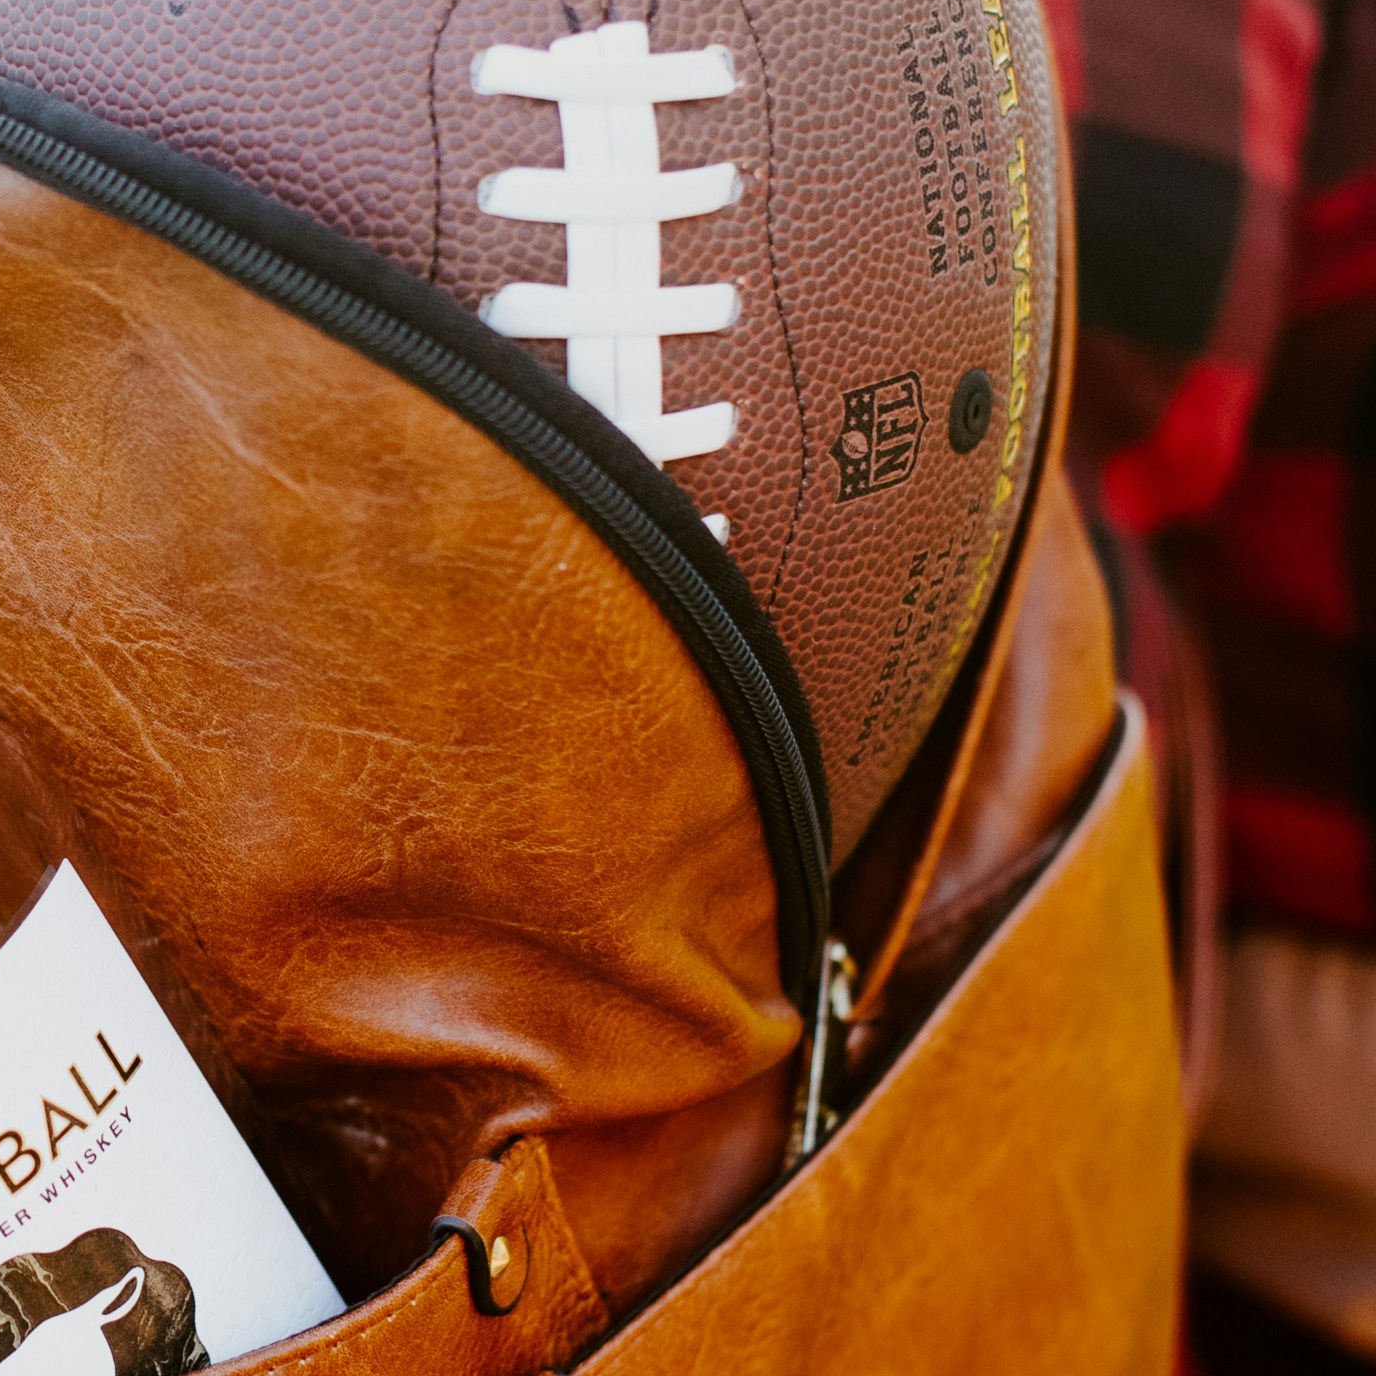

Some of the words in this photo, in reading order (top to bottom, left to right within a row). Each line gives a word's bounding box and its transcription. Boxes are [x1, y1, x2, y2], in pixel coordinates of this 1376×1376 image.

[897, 24, 948, 277] NATIONAL
[926, 7, 976, 269] FOOTBALL
[874, 381, 917, 486] NFL
[847, 550, 928, 766] AMERICAN
[40, 1105, 134, 1204] WHISKEY
